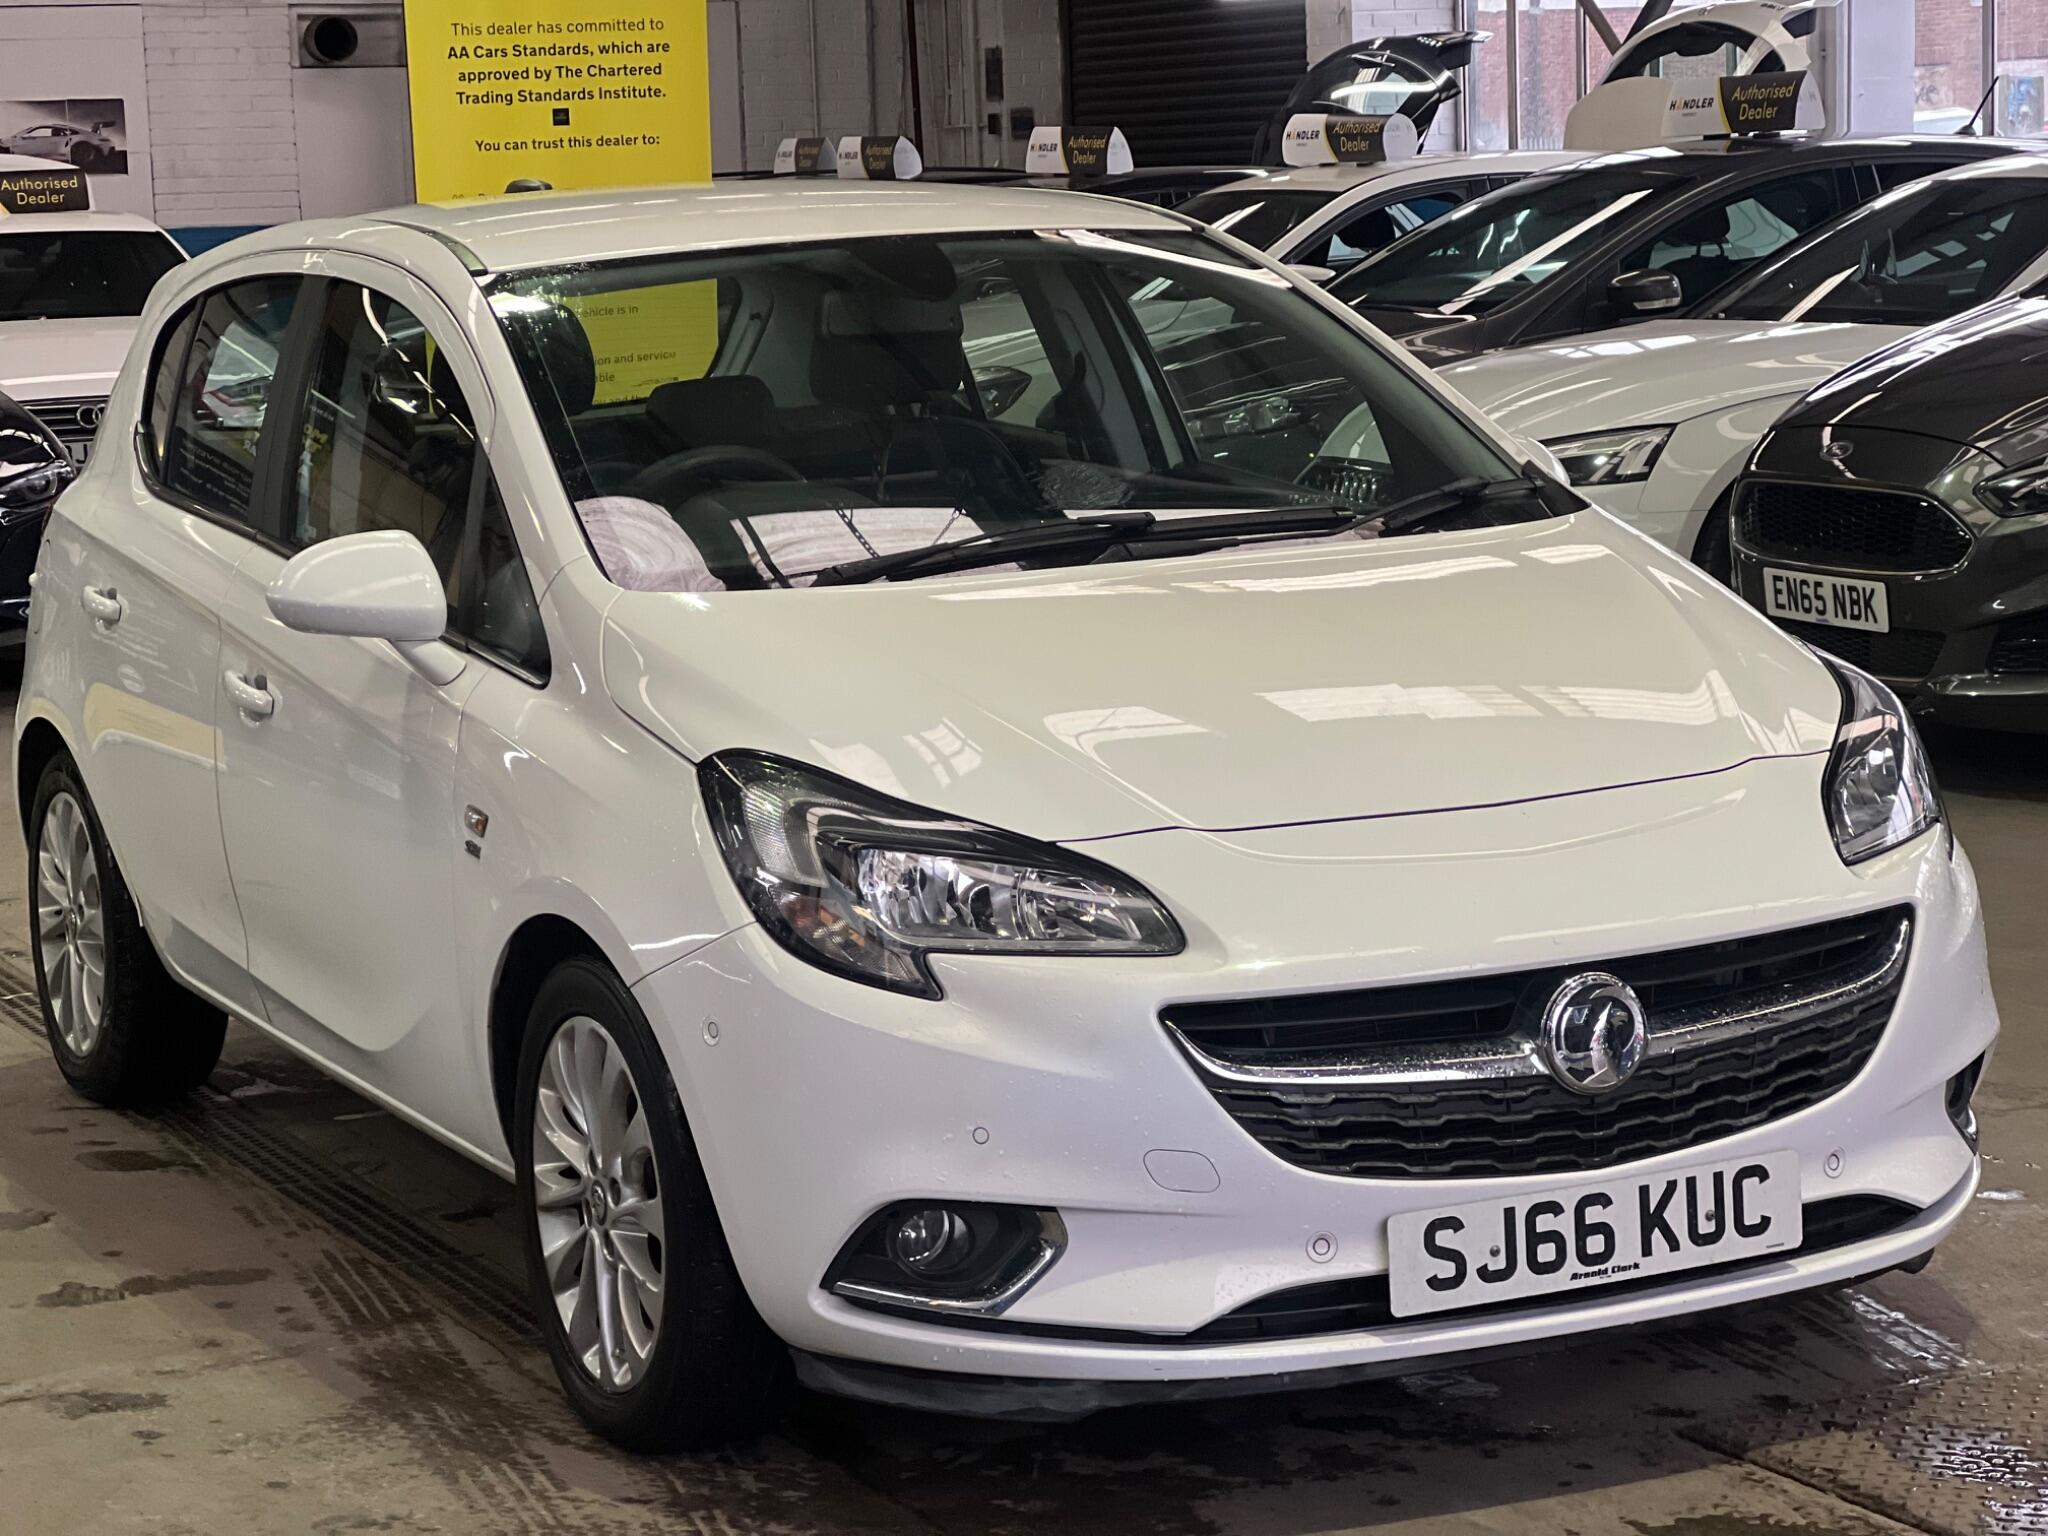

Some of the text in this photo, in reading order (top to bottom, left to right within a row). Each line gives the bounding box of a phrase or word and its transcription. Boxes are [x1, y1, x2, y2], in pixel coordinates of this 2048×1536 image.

[451, 18, 664, 36] This dealer has committed to
[447, 40, 670, 60] AA Cars Standards, which are
[458, 63, 662, 84] approved by The Chartered
[456, 85, 667, 106] Trading Standards Institute.
[1732, 81, 1795, 101] Authorised
[1739, 102, 1778, 120] Dealer
[1333, 121, 1381, 134] Authorised
[475, 134, 660, 152] You can trust this dealer to:
[1068, 133, 1107, 149] Authorised
[1340, 137, 1370, 152] Dealer
[1073, 150, 1096, 164] Dealer
[1, 176, 78, 191] Authorised
[16, 190, 65, 205] Dealer
[617, 305, 626, 315] is
[629, 304, 638, 314] in
[614, 352, 634, 364] and
[1772, 575, 1878, 624] EN65 NBK
[1423, 1163, 1772, 1292] SJ66 KUC
[1569, 1262, 1640, 1281] Arnold Clark
